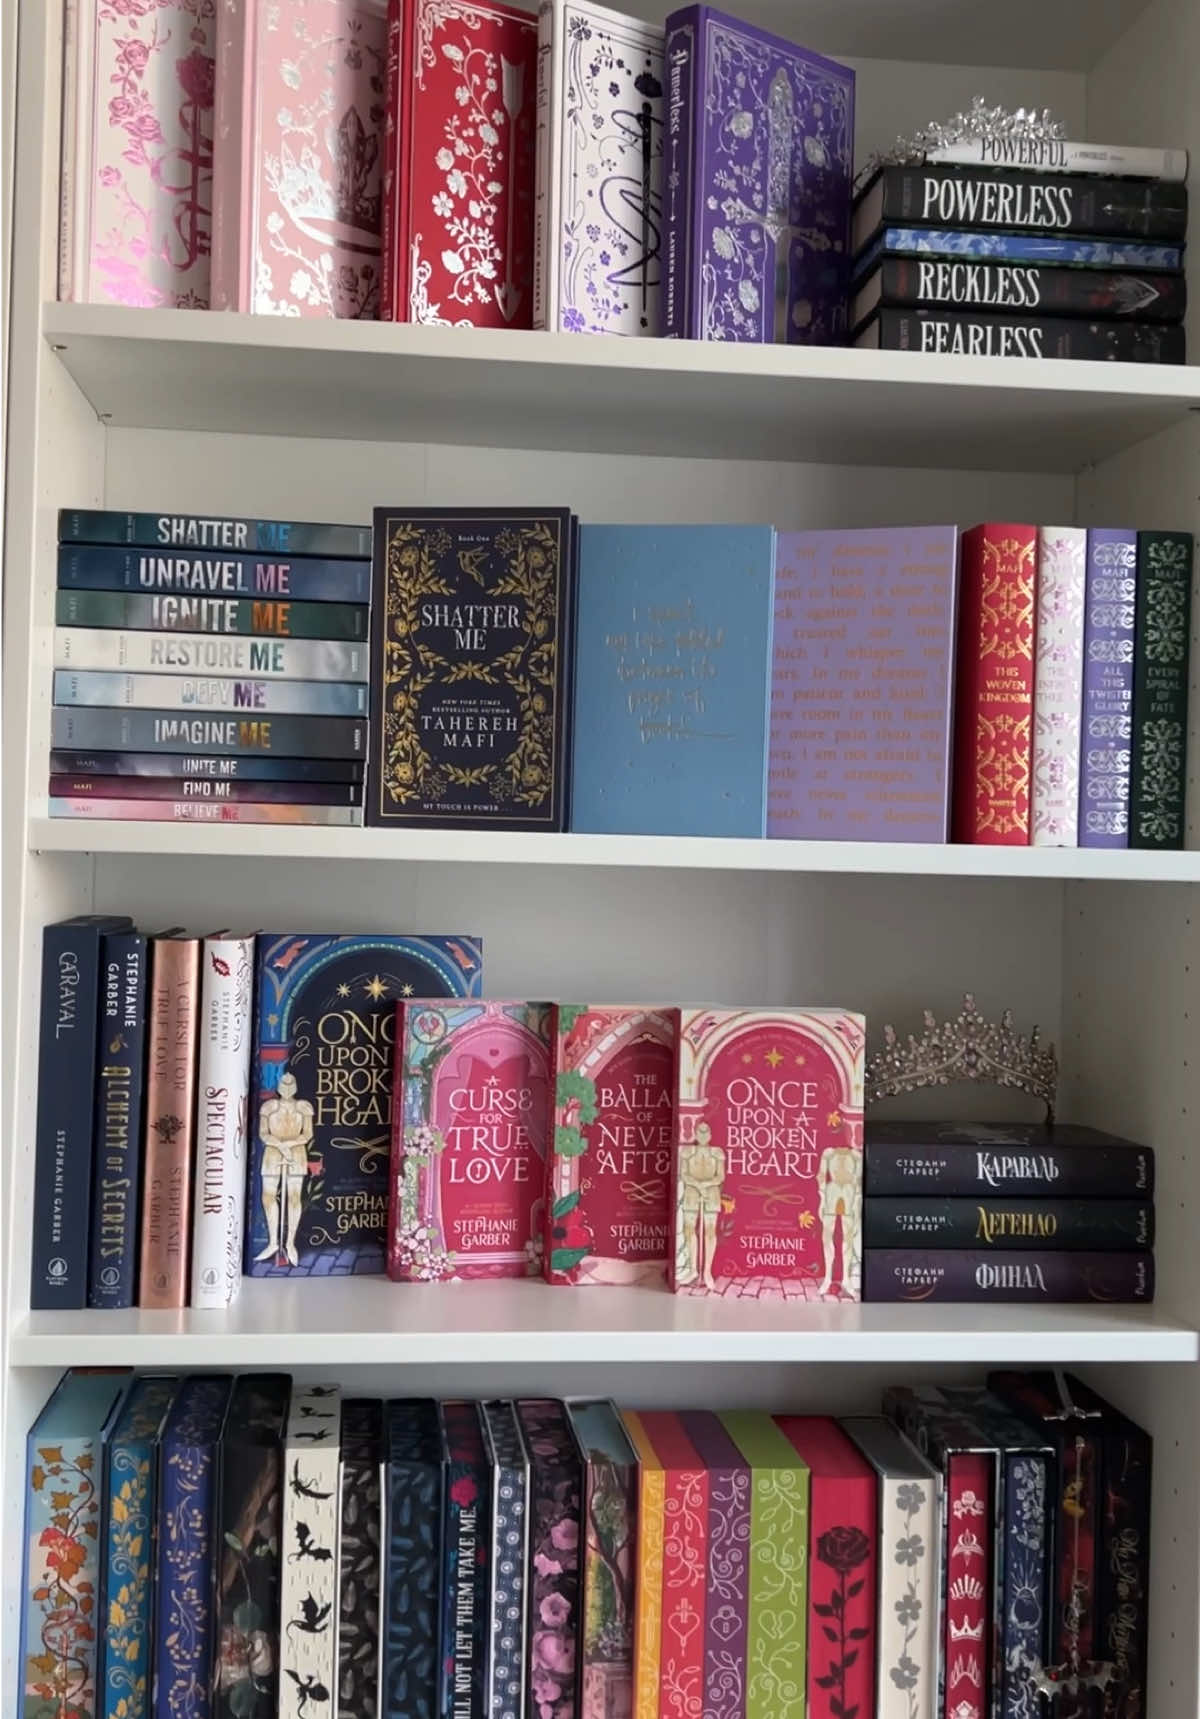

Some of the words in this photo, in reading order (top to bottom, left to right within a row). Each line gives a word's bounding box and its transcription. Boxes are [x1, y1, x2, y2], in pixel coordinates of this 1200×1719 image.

[670, 49, 689, 134] Powerless
[981, 138, 1069, 167] POWERFUL
[921, 178, 1072, 228] POWERLESS
[668, 231, 676, 273] LAUREN
[917, 262, 1040, 308] RECKLESS
[667, 277, 675, 326] ROBERTS
[920, 321, 1043, 359] FEARLESS
[157, 517, 248, 548] SHATTER
[256, 522, 291, 553] ME
[140, 557, 249, 592] UNRAVEL
[255, 564, 291, 594] ME
[152, 596, 239, 632] IGNITE
[252, 601, 291, 636] ME
[421, 604, 521, 630] SHATTER
[455, 629, 487, 651] ME
[150, 638, 244, 668] RESTORE
[250, 642, 285, 672] ME
[985, 680, 1027, 691] WOVEN
[994, 666, 1020, 678] THIS
[1103, 667, 1124, 677] ALL
[1103, 678, 1125, 688] THIS
[181, 680, 230, 705] DEFY
[233, 682, 267, 709] ME
[979, 692, 1031, 704] KINGDOM
[154, 719, 237, 746] IMAGINE
[239, 722, 272, 749] ME
[421, 715, 518, 732] TAHEREH
[443, 733, 496, 748] MAFI
[183, 760, 217, 775] UNITE
[219, 760, 238, 775] ME
[183, 782, 211, 797] FIND
[215, 783, 232, 797] ME
[174, 804, 220, 819] BELIEVE
[221, 807, 240, 821] ME
[56, 951, 80, 1039] CARAVAL
[106, 963, 119, 1017] GARBER
[125, 953, 139, 1028] STEPHANIE
[155, 987, 170, 1036] TRUE
[209, 1000, 219, 1042] GARBER
[220, 992, 230, 1051] STEPHANIE
[318, 1010, 395, 1045] ONC
[154, 1039, 169, 1082] LOVE
[318, 1045, 389, 1067] UPON
[317, 1068, 390, 1097] BROK
[634, 1074, 657, 1085] THE
[726, 1077, 818, 1109] ONCE
[101, 1065, 132, 1151] ALCHEMY
[315, 1096, 391, 1127] HEA
[450, 1087, 533, 1118] CURSE
[601, 1083, 672, 1112] BALLA
[479, 1112, 503, 1124] FOR
[636, 1112, 653, 1122] OF
[727, 1106, 785, 1126] UPON
[792, 1111, 816, 1127] A
[450, 1124, 530, 1156] TRUE
[598, 1122, 671, 1148] NEVE
[727, 1126, 817, 1151] BROKEN
[54, 1130, 66, 1195] STEPHANIE
[203, 1086, 229, 1216] SPECTACULAR
[597, 1149, 671, 1175] AFTE
[727, 1149, 818, 1179] HEART
[896, 1159, 947, 1168] СТЕФАНИ
[450, 1157, 530, 1184] LOVE
[903, 1167, 941, 1176] ГАРБЕР
[149, 1180, 163, 1244] GARBER
[167, 1167, 182, 1256] STEPHANIE
[326, 1191, 388, 1213] STEPHA
[52, 1198, 63, 1243] GARBER
[101, 1178, 131, 1258] SECRETS
[337, 1214, 388, 1235] GARBE
[453, 1216, 519, 1233] STEPHANIE
[610, 1221, 669, 1238] STEPHANI
[896, 1215, 946, 1224] СТЕФАНИ
[902, 1223, 940, 1232] ГАРБЕР
[461, 1234, 510, 1250] GARBER
[618, 1238, 665, 1254] GARBER
[740, 1233, 806, 1251] STEPHANIE
[746, 1252, 796, 1268] GARBER
[894, 1268, 945, 1276] СТЕФАНИ
[901, 1276, 938, 1285] ГАРБЕР
[976, 1263, 1048, 1292] ФИНАЛ
[460, 1506, 477, 1533] ME.
[459, 1536, 476, 1578] TAKE
[457, 1582, 474, 1627] THEM
[456, 1630, 473, 1659] LET
[455, 1663, 473, 1693] NOT
[455, 1698, 472, 1719] ILL
